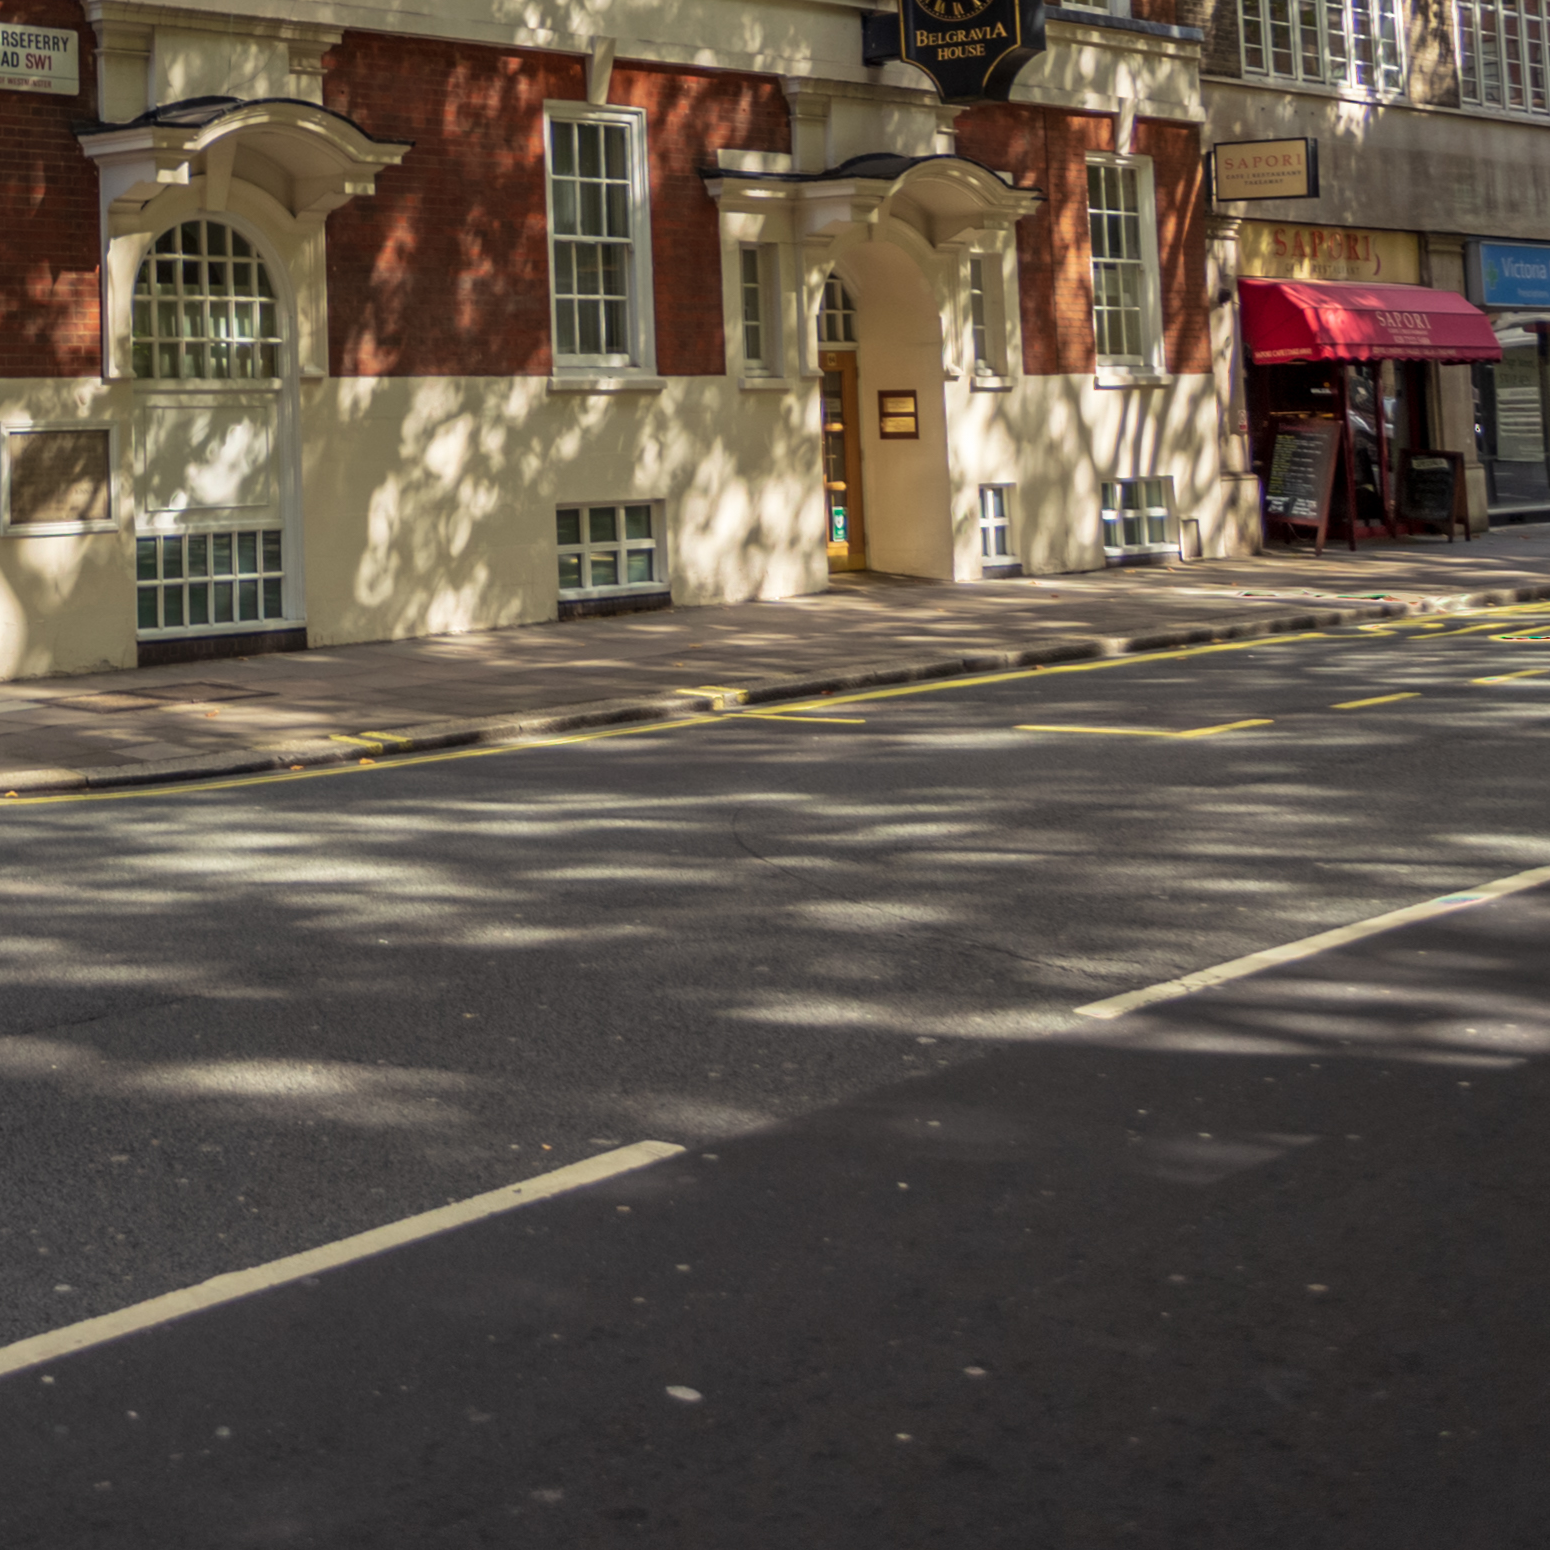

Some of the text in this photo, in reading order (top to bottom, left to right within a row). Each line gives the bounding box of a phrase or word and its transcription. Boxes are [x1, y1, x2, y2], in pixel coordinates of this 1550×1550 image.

[25, 52, 52, 71] SW1
[938, 43, 985, 61] HOUSE
[7, 77, 52, 89] WESTMNSTER
[1224, 153, 1302, 170] SAPORI
[1273, 228, 1371, 261] SAPORI
[1501, 257, 1548, 279] Victoria
[1375, 310, 1432, 329] SAPORI
